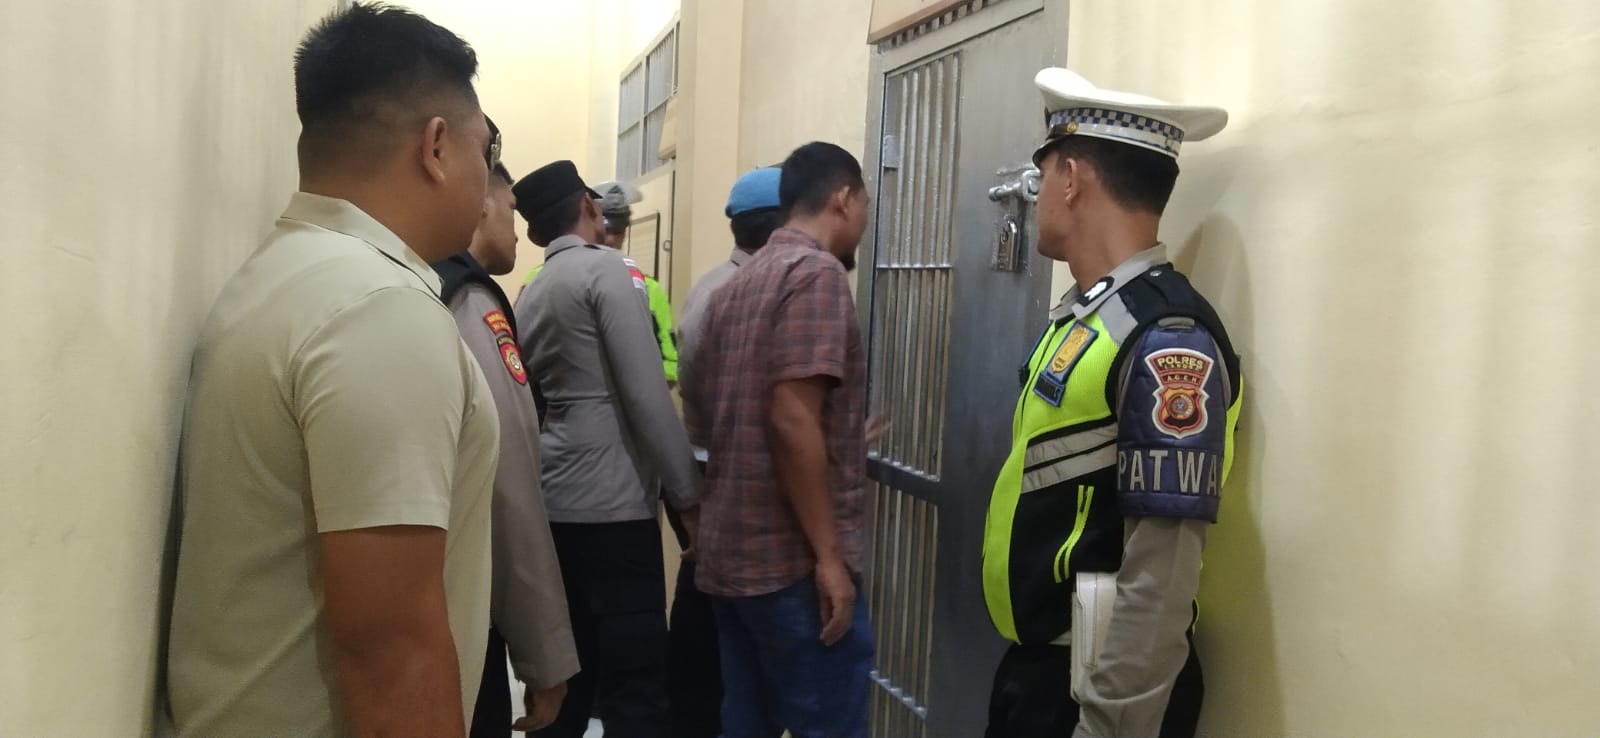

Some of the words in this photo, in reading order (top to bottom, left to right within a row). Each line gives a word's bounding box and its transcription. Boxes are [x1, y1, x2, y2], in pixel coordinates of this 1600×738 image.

[1157, 355, 1203, 368] POLRES
[1167, 375, 1197, 383] ACEH
[1117, 450, 1220, 496] PATWA
